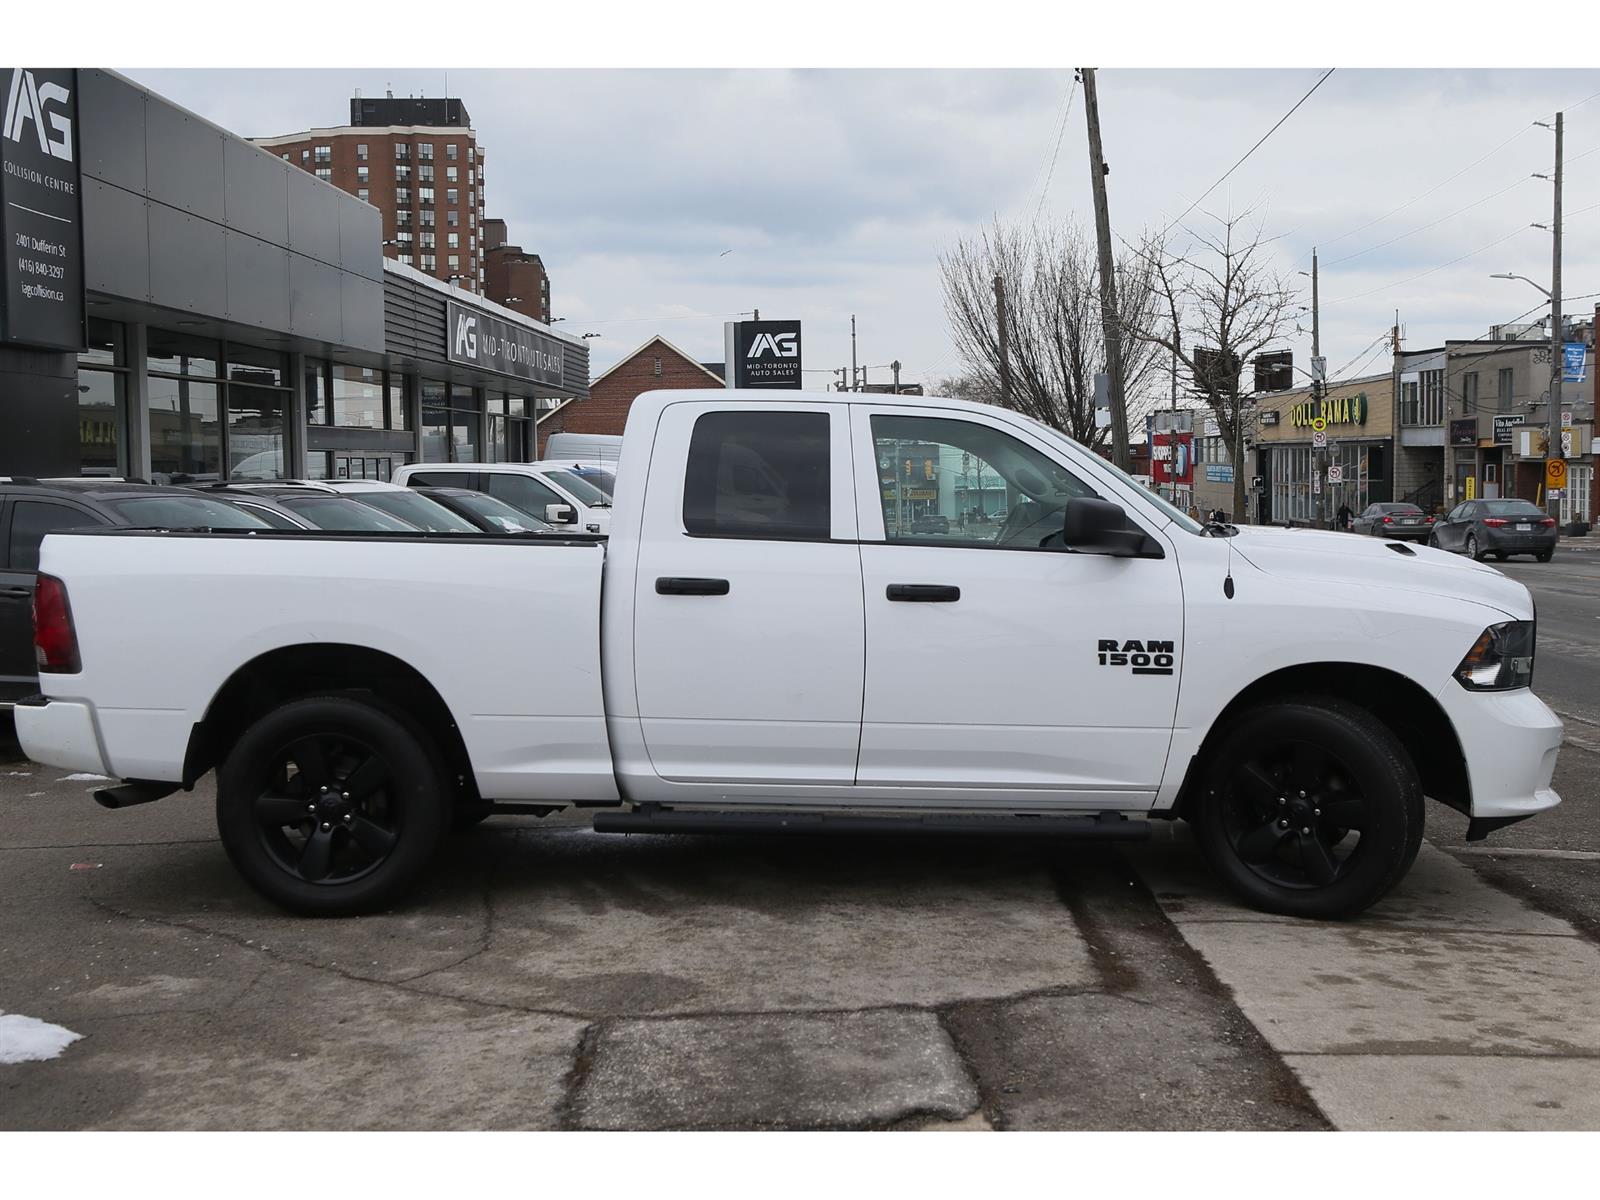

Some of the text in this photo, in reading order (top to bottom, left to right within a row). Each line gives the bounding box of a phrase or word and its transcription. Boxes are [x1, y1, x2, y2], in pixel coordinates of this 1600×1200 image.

[3, 160, 75, 195] COLLISION CENTRE
[16, 232, 31, 248] 2401
[31, 238, 58, 256] Dufferin
[18, 257, 64, 279] (416) 840-3297
[1290, 398, 1350, 427] DOLLRAMA
[1098, 639, 1174, 653] RAM
[1098, 653, 1174, 667] 1500
